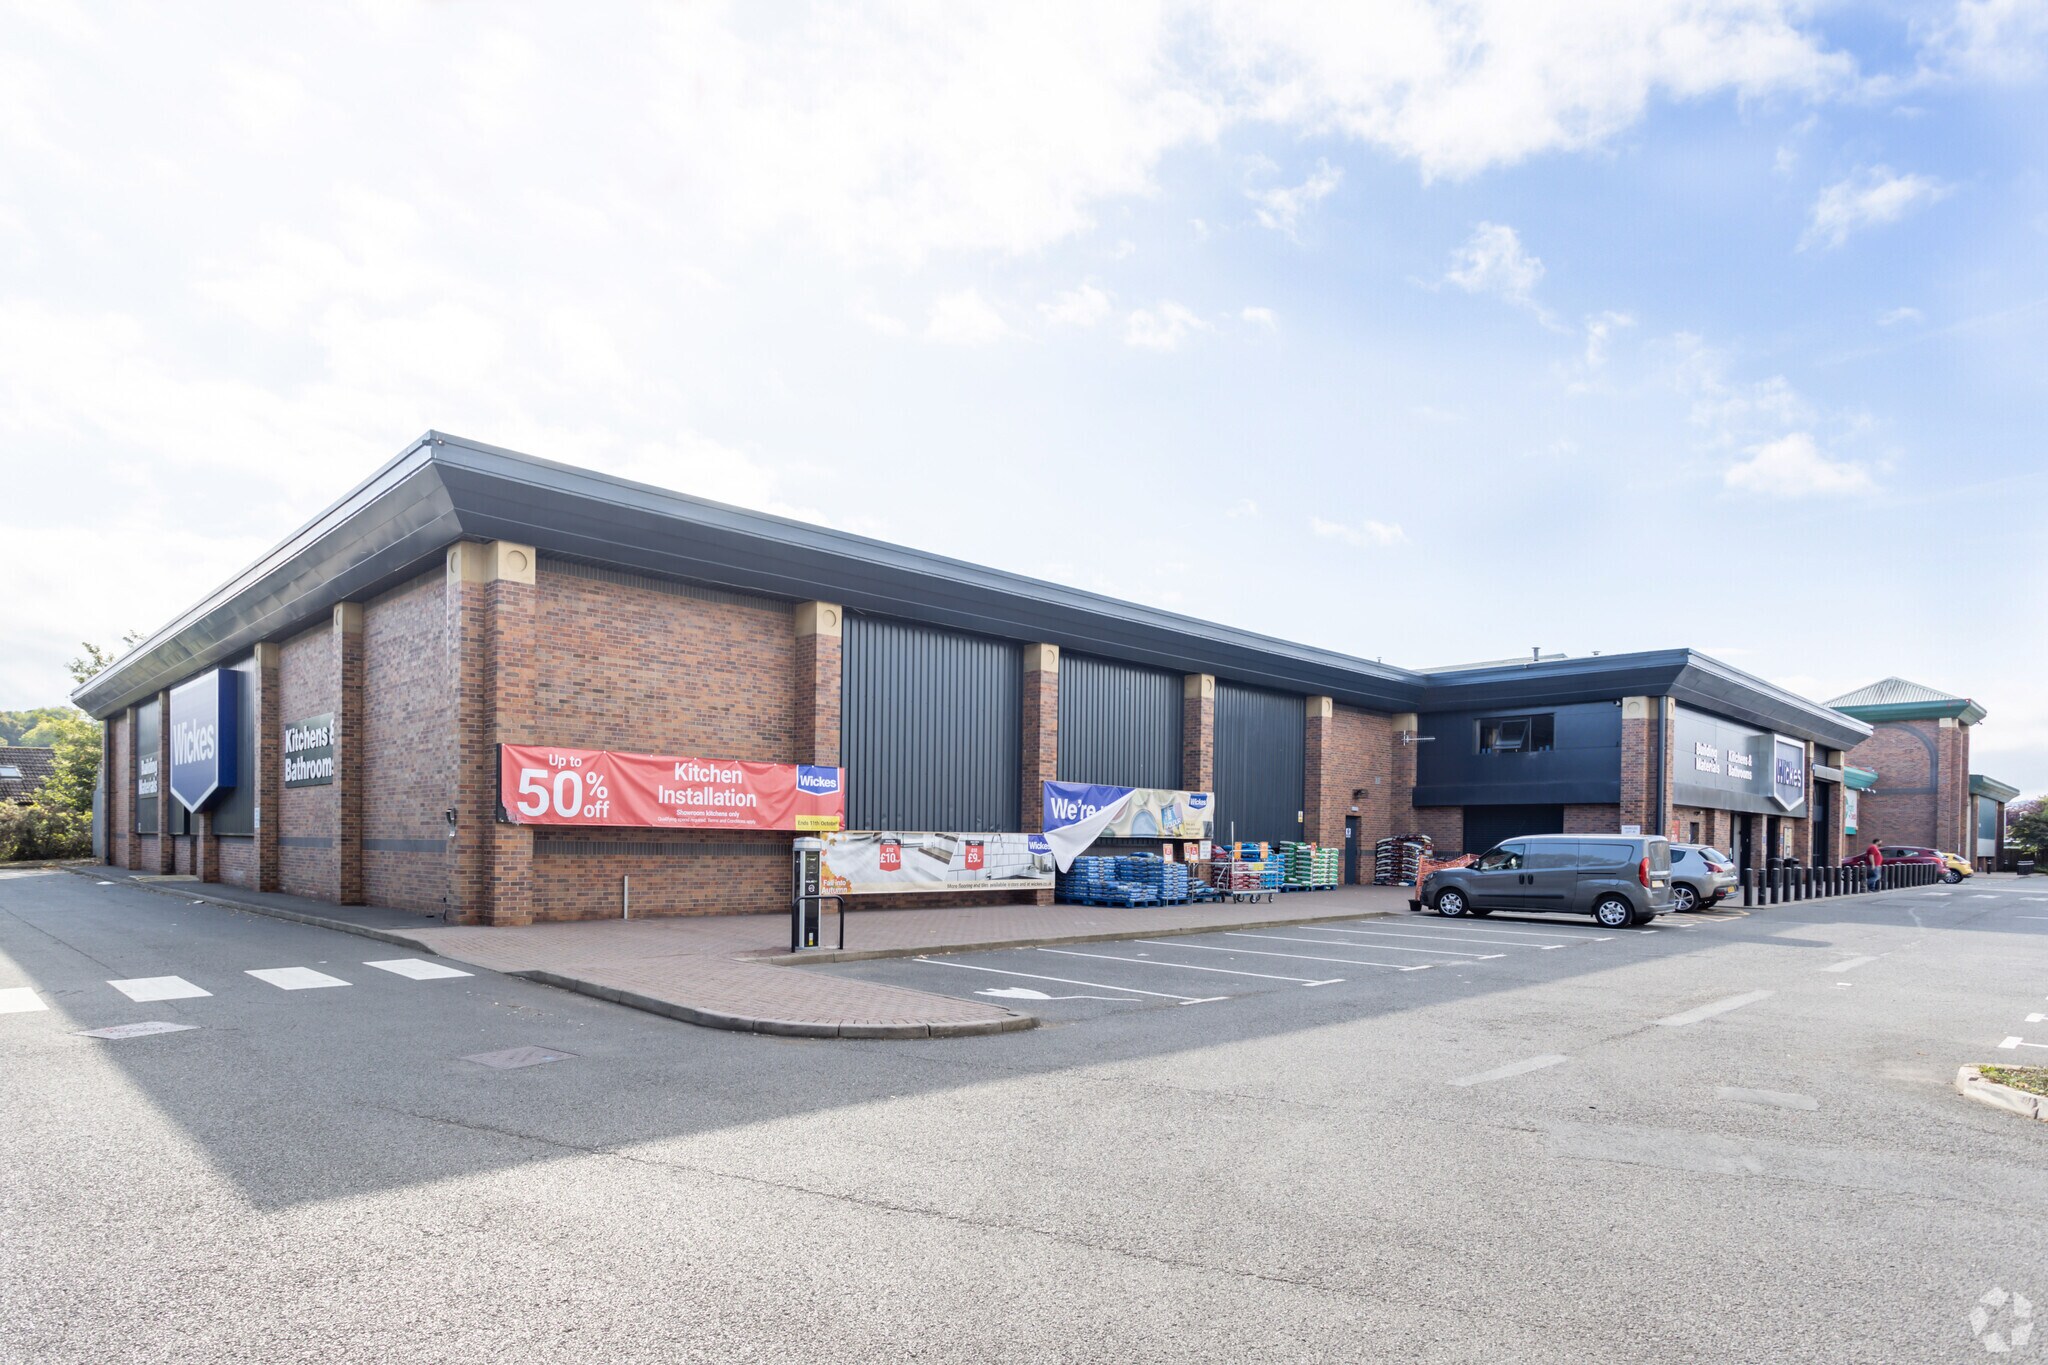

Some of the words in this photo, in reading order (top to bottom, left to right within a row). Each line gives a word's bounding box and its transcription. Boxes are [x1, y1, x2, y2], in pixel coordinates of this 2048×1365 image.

[173, 719, 214, 766] Wickes
[285, 725, 328, 753] Kitchens
[1695, 742, 1718, 762] Building
[1728, 750, 1748, 766] Kitchens
[1748, 754, 1752, 766] &
[549, 754, 567, 769] Up
[569, 755, 582, 768] to
[1695, 757, 1720, 774] Materials
[674, 762, 743, 784] Kitchen
[1728, 764, 1752, 780] Bathrooms
[1776, 758, 1802, 787] Wickes
[138, 776, 157, 794] Materials
[800, 775, 837, 788] Wickes
[658, 785, 757, 808] Installation
[1190, 798, 1207, 806] Wickes
[583, 801, 610, 818] off
[880, 853, 896, 863] £10
[968, 853, 978, 863] £9
[821, 886, 848, 894] Autumn
